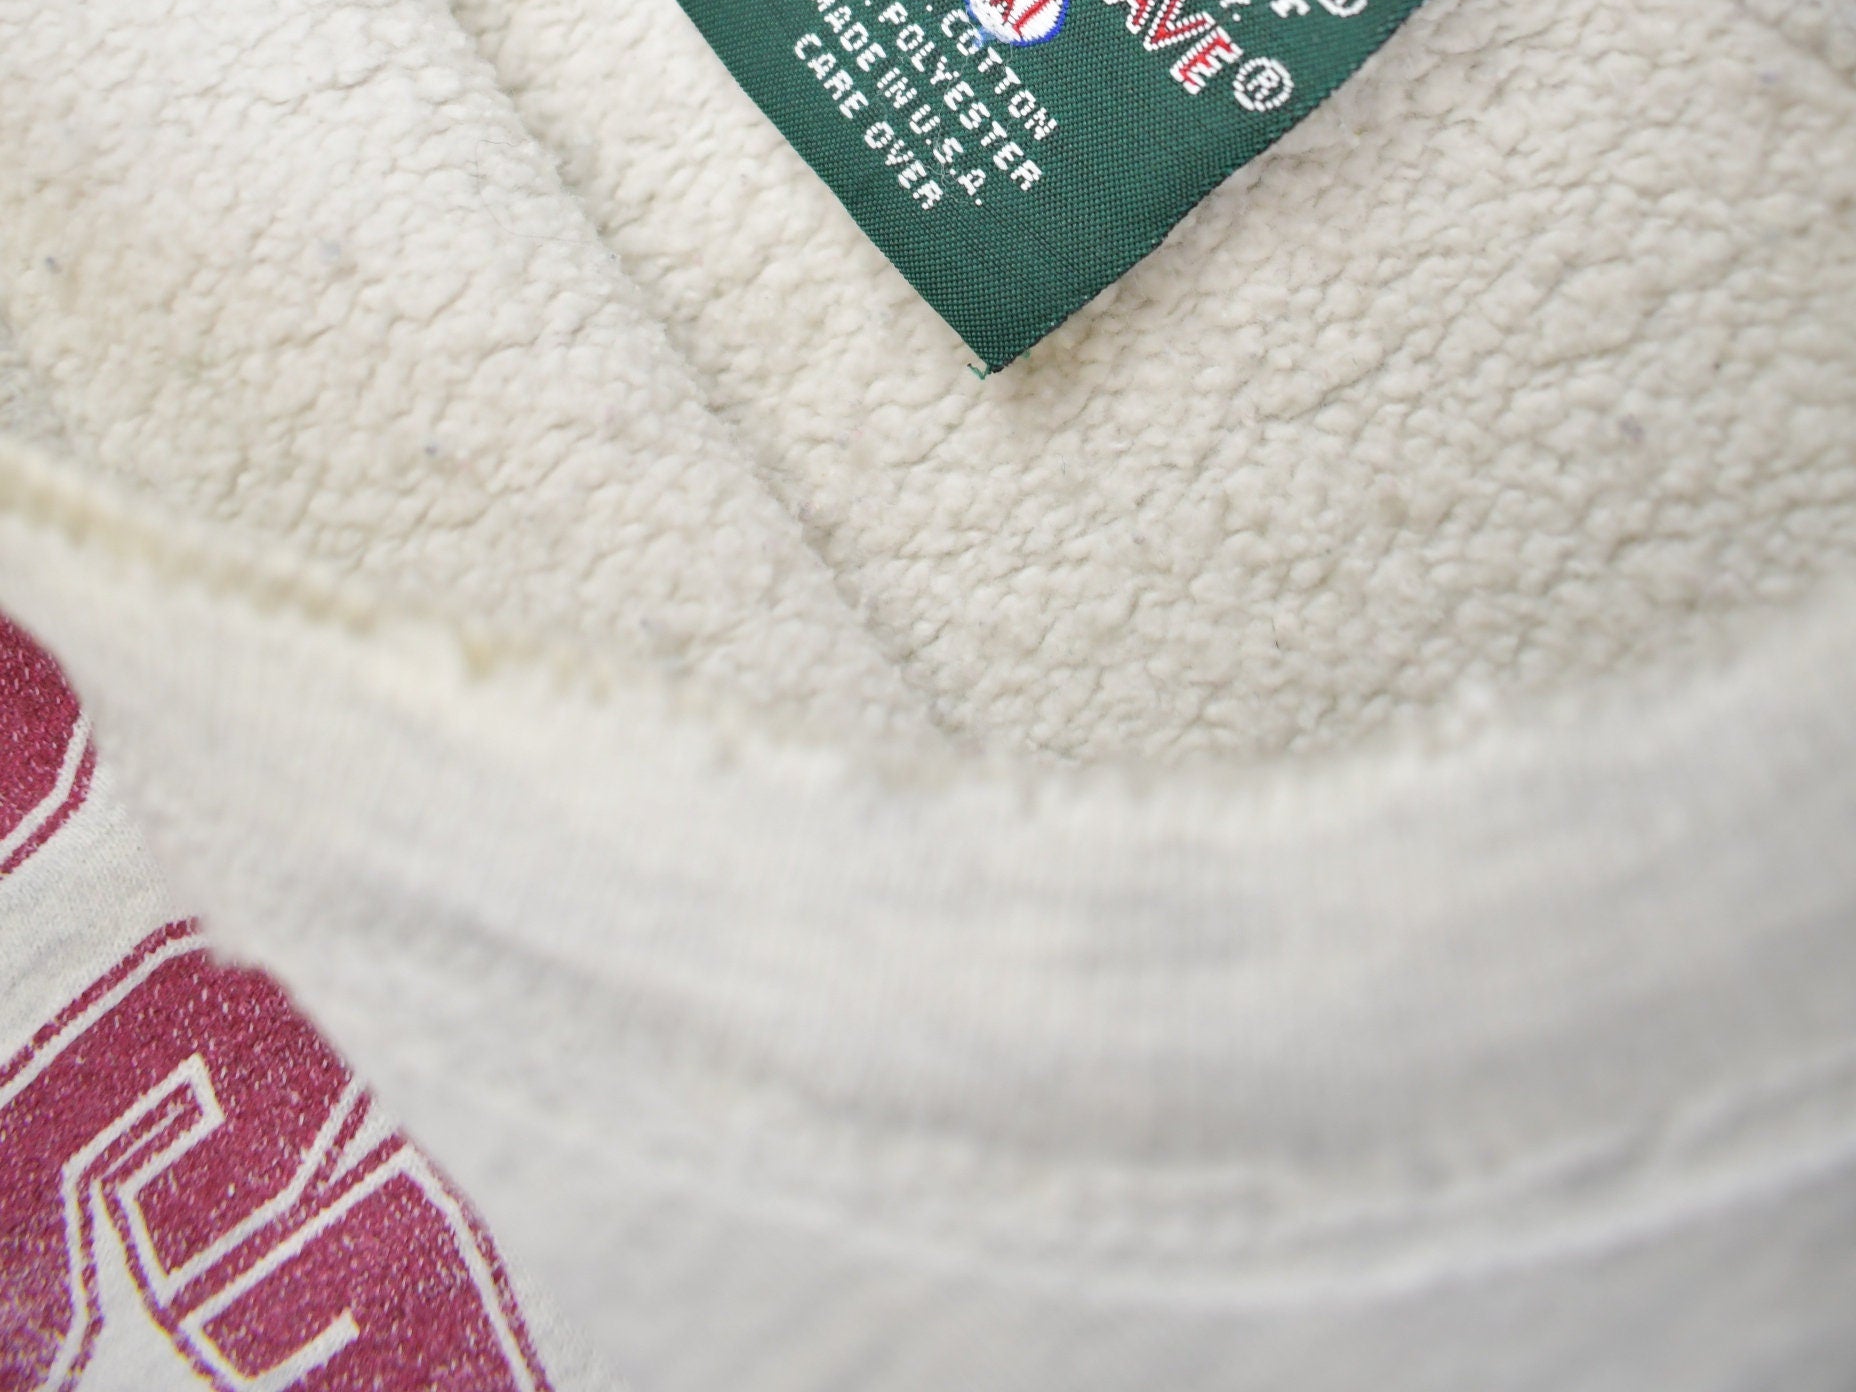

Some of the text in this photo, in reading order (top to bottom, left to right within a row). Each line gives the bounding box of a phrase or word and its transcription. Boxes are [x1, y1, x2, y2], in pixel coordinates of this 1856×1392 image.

[794, 32, 943, 210] CARE OVER
[876, 67, 918, 109] IN
[909, 104, 986, 206] U.S.A.
[878, 1, 1043, 192] POLYESTER
[942, 8, 1058, 141] COTTON
